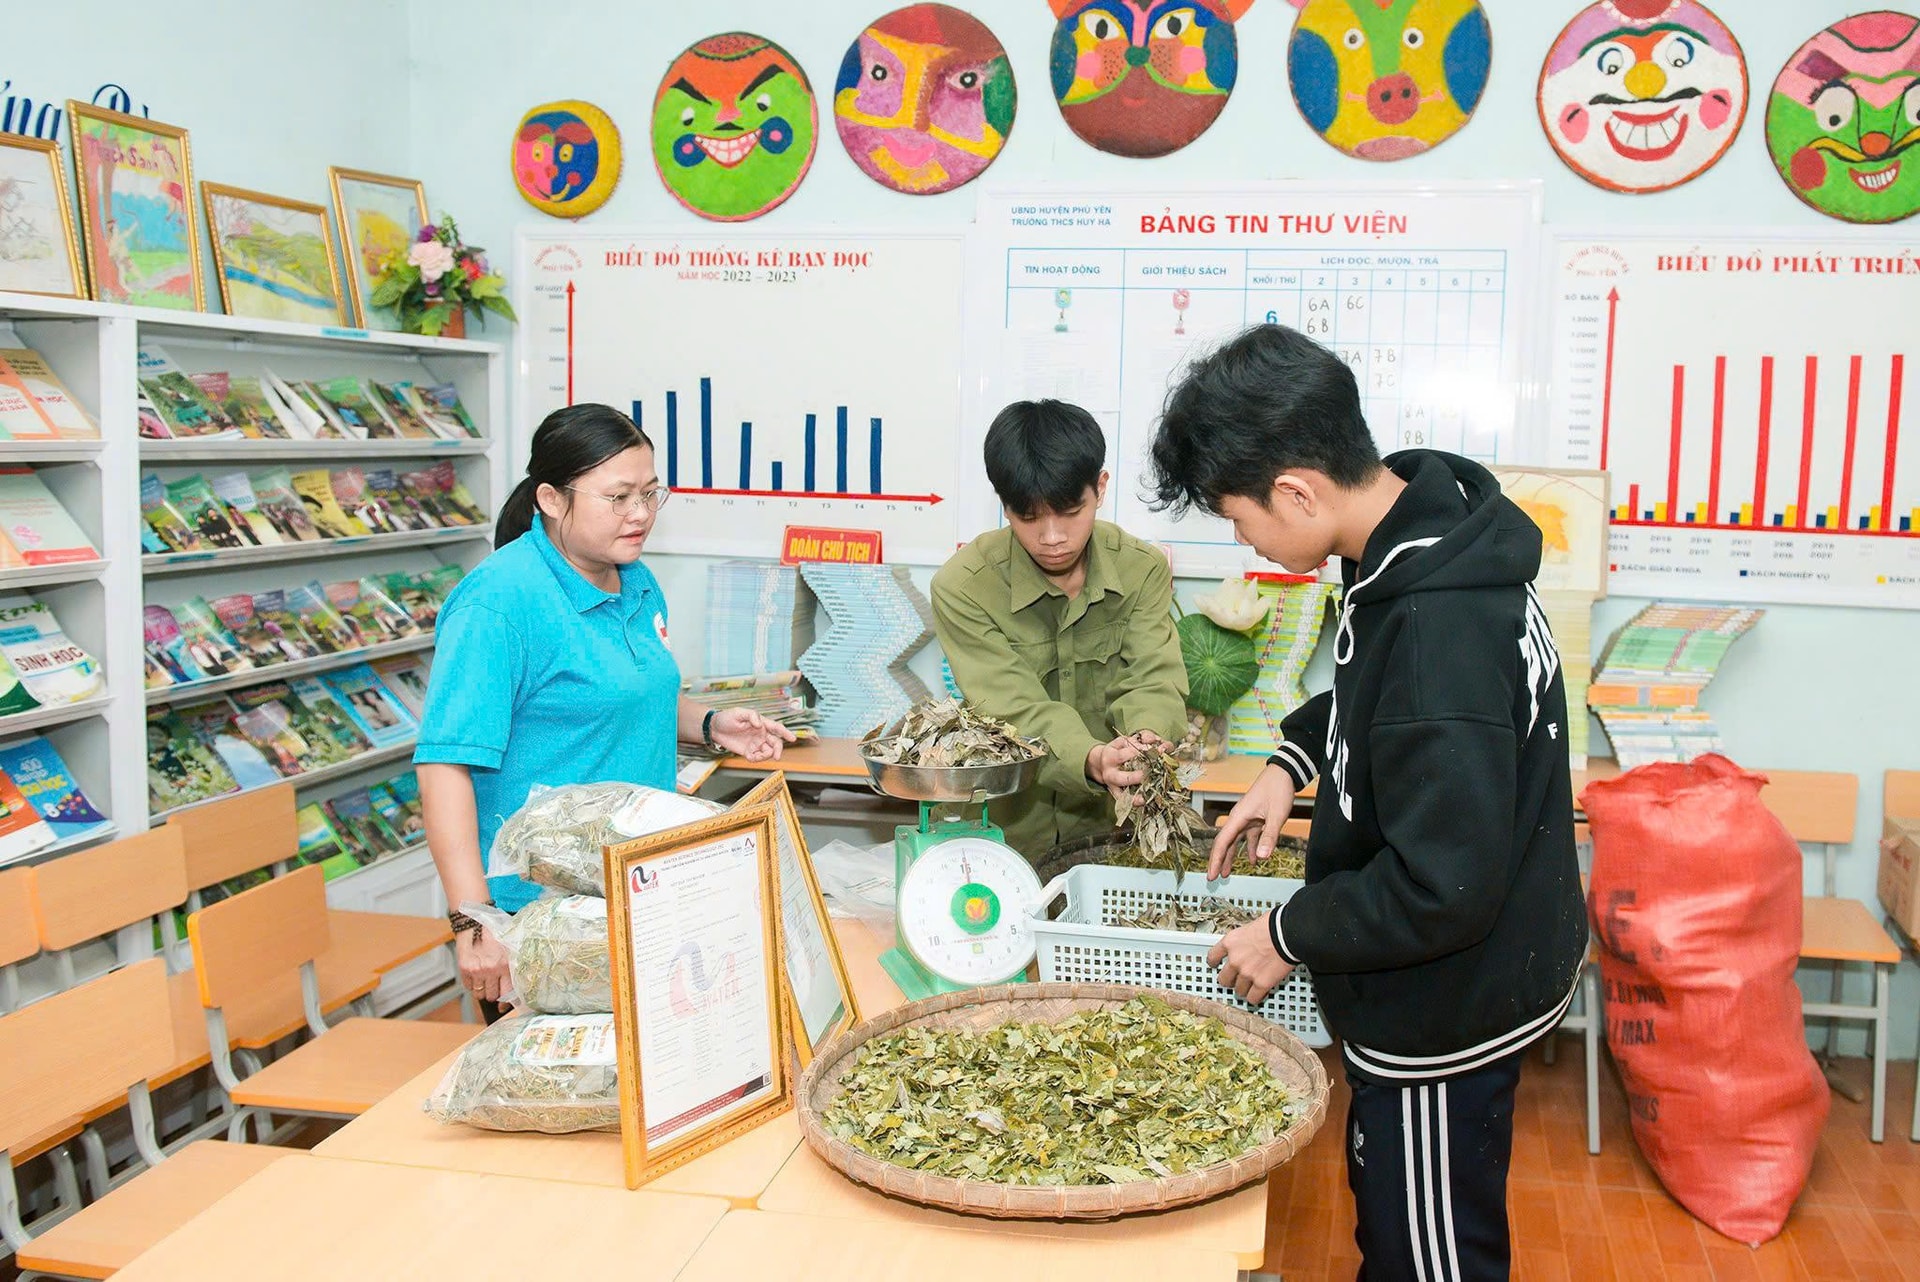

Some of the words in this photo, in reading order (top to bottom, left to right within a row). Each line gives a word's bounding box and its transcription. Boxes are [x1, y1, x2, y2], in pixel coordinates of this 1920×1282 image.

[1011, 206, 1036, 215] UBND
[1039, 205, 1070, 215] HUYỆN
[1093, 205, 1112, 215] YÊN
[1051, 218, 1074, 226] THCS
[1077, 218, 1095, 226] HUY
[1140, 206, 1216, 234] BẢNG
[1225, 214, 1269, 234] TIN
[1279, 213, 1335, 234] THƯ
[1344, 210, 1408, 240] VIỆN
[605, 243, 648, 267] BIỂU
[654, 244, 680, 267] ĐỒ
[687, 244, 749, 267] THỐNG
[757, 248, 782, 267] KÊ
[788, 251, 827, 273] BẠN
[834, 251, 873, 273] ĐỌC
[1657, 245, 1717, 272] BIỂU
[1726, 248, 1762, 272] ĐỒ
[1773, 249, 1842, 273] PHÁT
[1025, 266, 1039, 274] TIN
[1042, 265, 1068, 276] HOẠT
[1199, 265, 1227, 275] SÁCH
[723, 270, 751, 282] 2022
[767, 270, 797, 283] 2023
[1318, 277, 1325, 286] 2
[1352, 277, 1359, 286] 3
[1386, 278, 1392, 286] 4
[1420, 278, 1426, 286] 5
[1452, 278, 1459, 286] 6
[1485, 278, 1491, 286] 7
[1265, 310, 1278, 325] 6
[821, 532, 845, 560] CHỦ
[847, 542, 871, 565] TỊCH
[15, 653, 53, 671] SINH
[77, 661, 92, 674] 7
[1547, 722, 1558, 740] F
[43, 802, 60, 818] 8
[959, 863, 972, 874] 15
[1010, 924, 1017, 935] 5
[928, 935, 941, 946] 10
[1622, 1019, 1656, 1045] MAX
